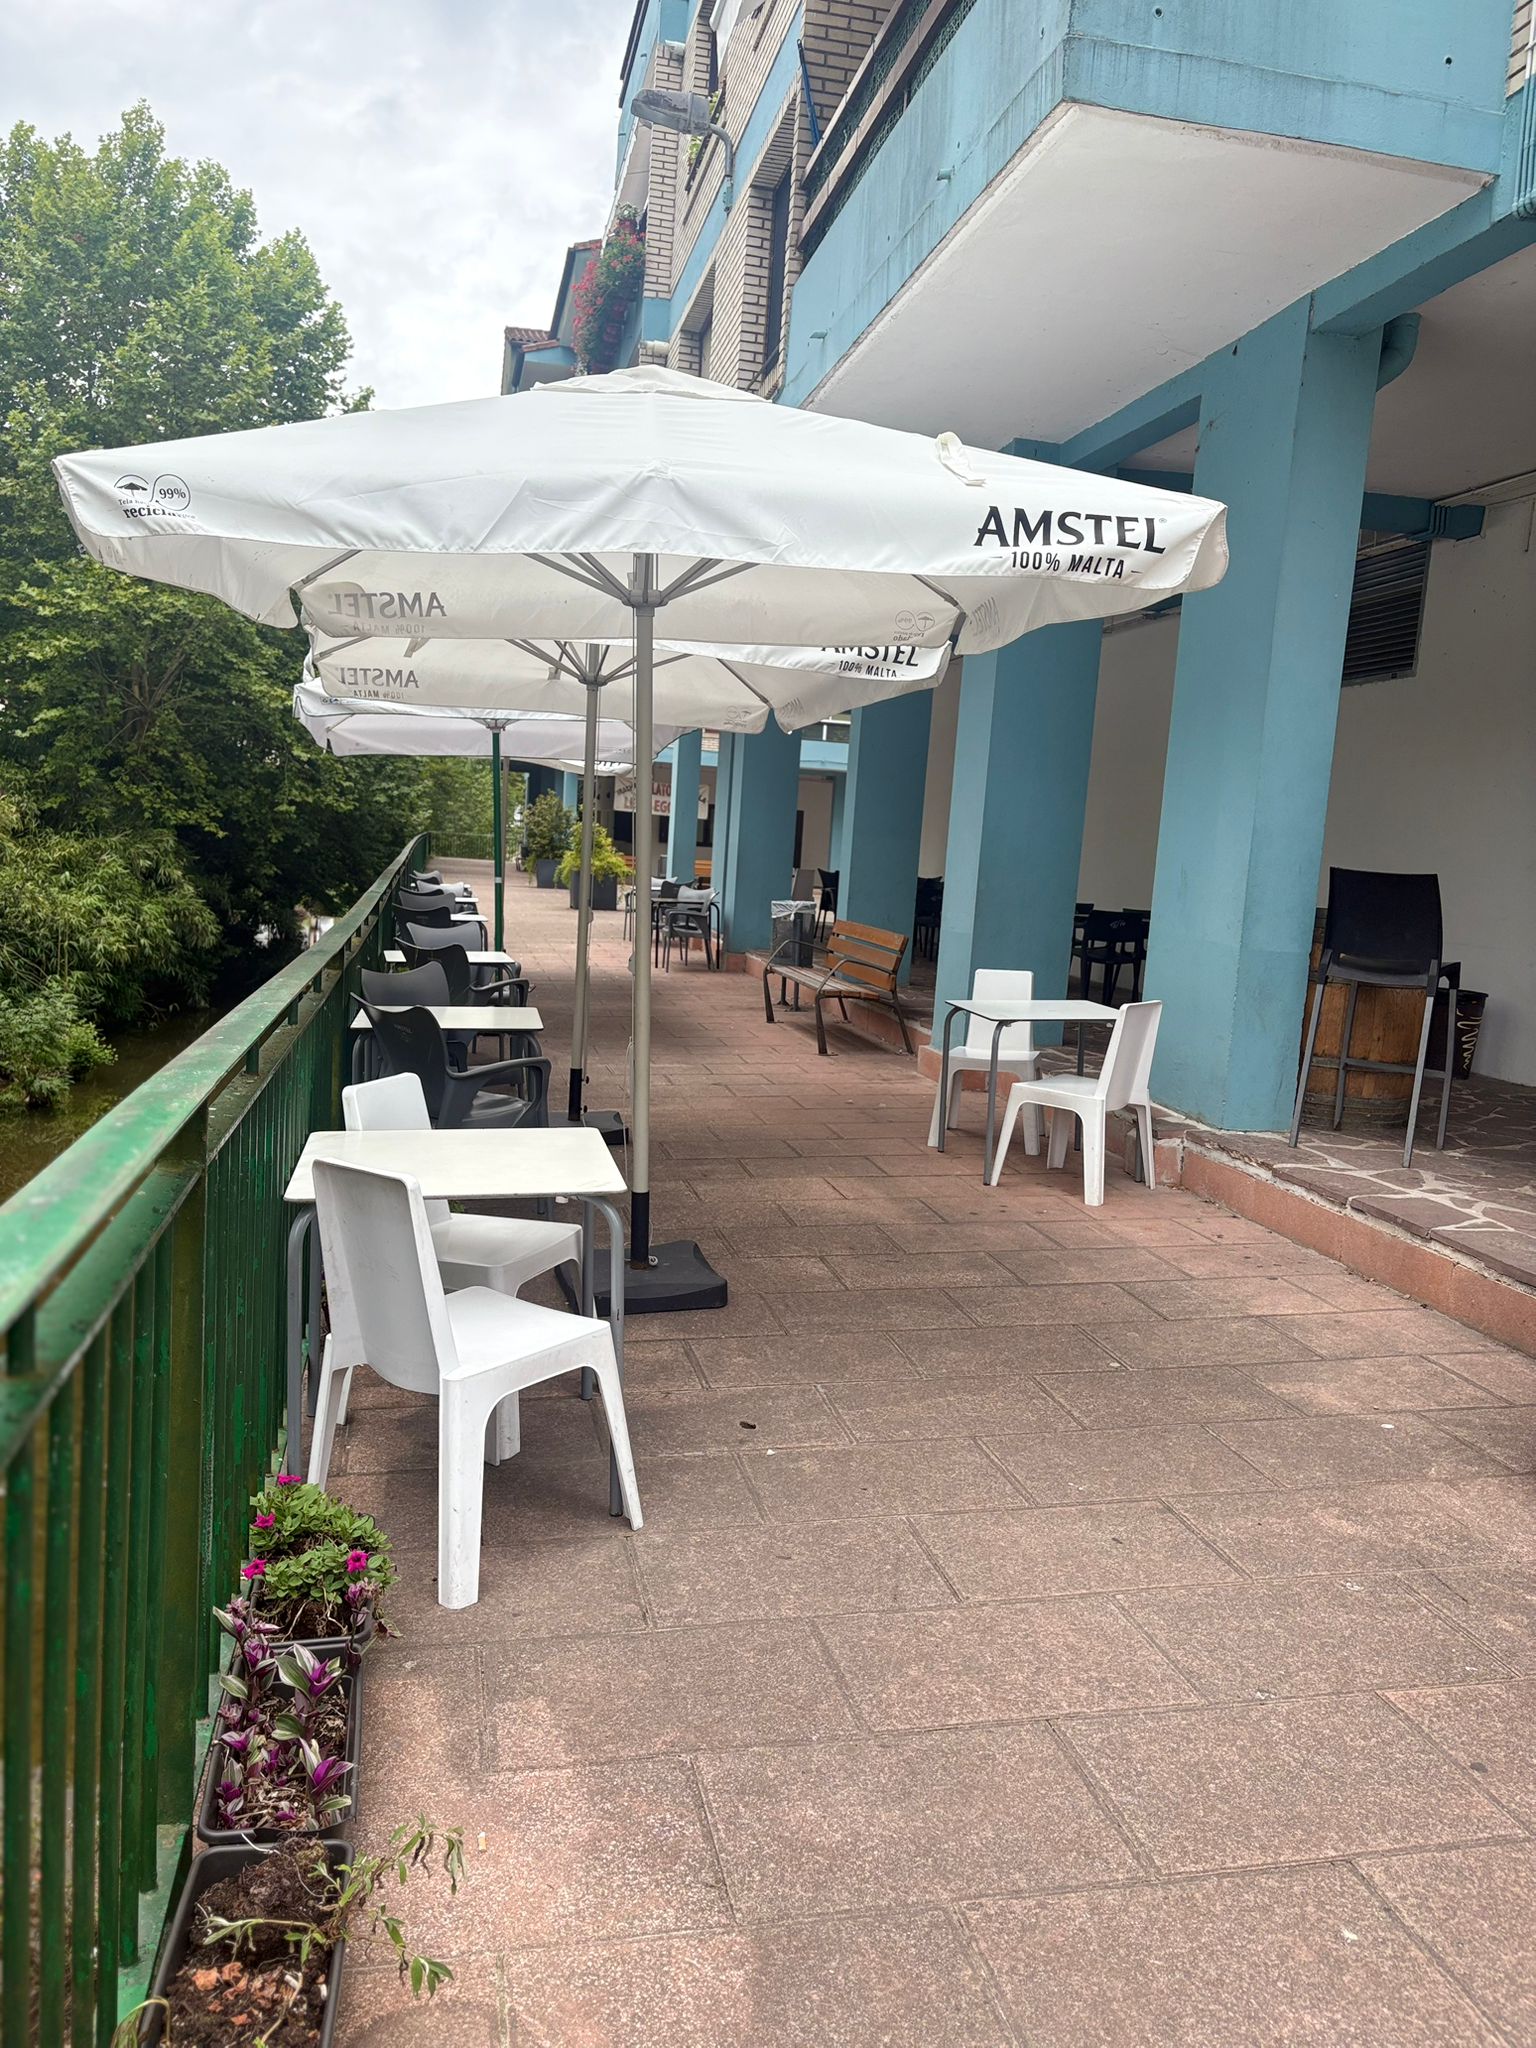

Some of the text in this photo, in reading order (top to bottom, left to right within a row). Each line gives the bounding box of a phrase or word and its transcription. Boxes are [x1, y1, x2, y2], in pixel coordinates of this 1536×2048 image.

[159, 488, 187, 500] 99%
[974, 506, 1166, 554] AMSTEL
[1011, 551, 1125, 579] 100% MALTA
[821, 645, 918, 667] STEL
[838, 660, 897, 678] 100% MALTA
